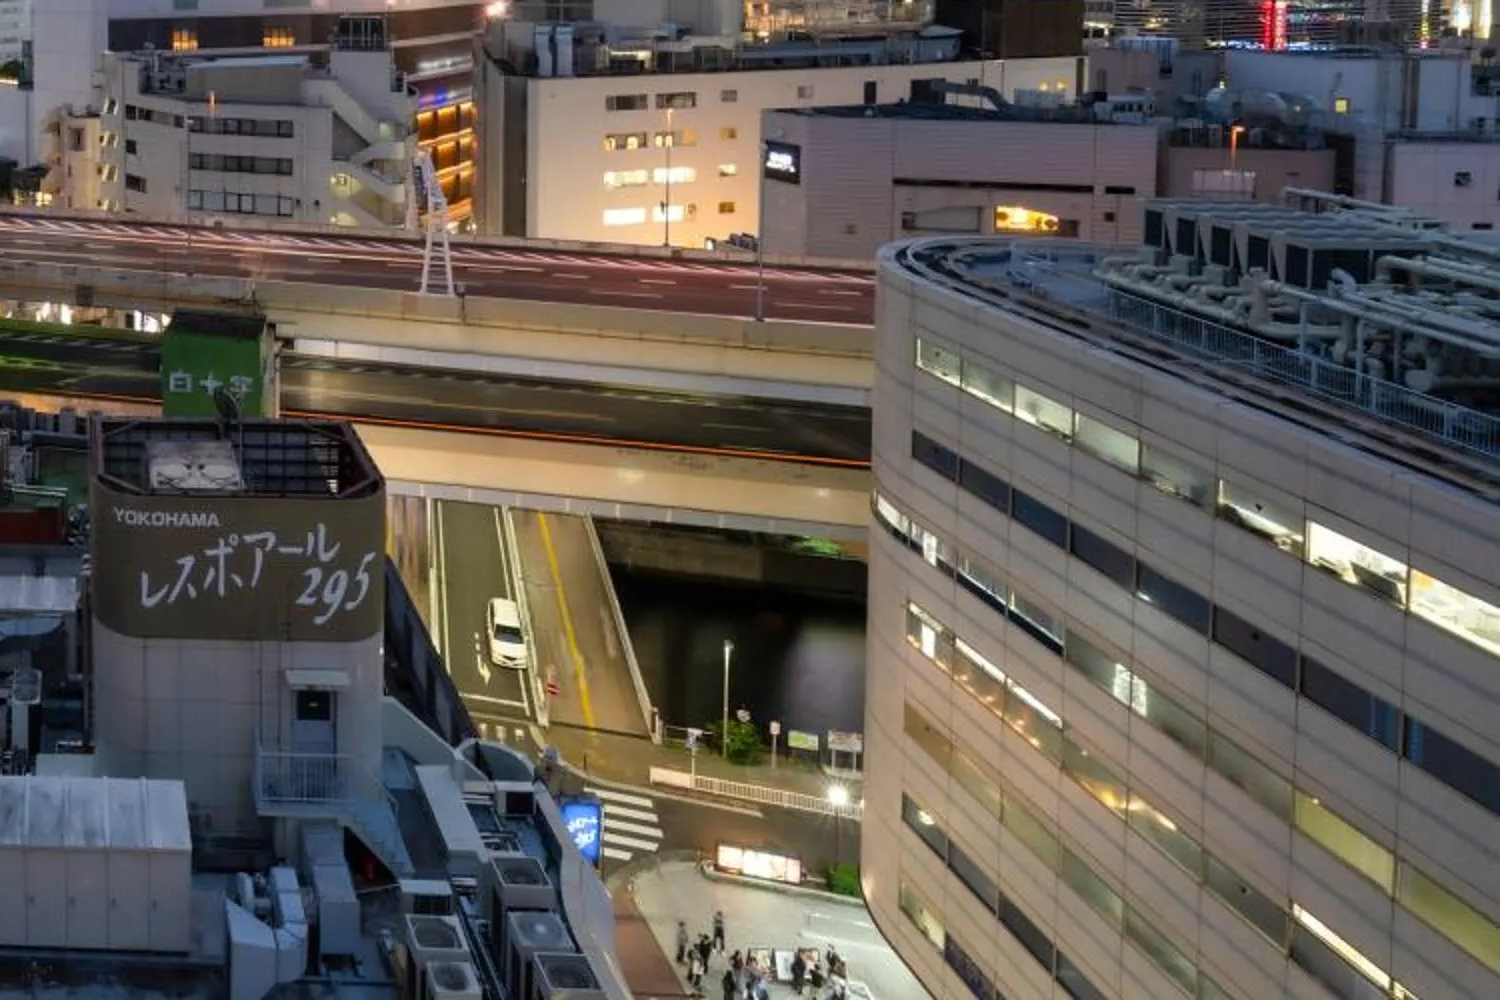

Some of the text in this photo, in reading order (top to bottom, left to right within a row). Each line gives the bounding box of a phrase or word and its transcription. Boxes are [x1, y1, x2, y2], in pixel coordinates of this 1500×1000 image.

[114, 507, 221, 529] YOKOHAMA
[140, 523, 342, 609] レスポアール
[295, 552, 377, 626] 295
